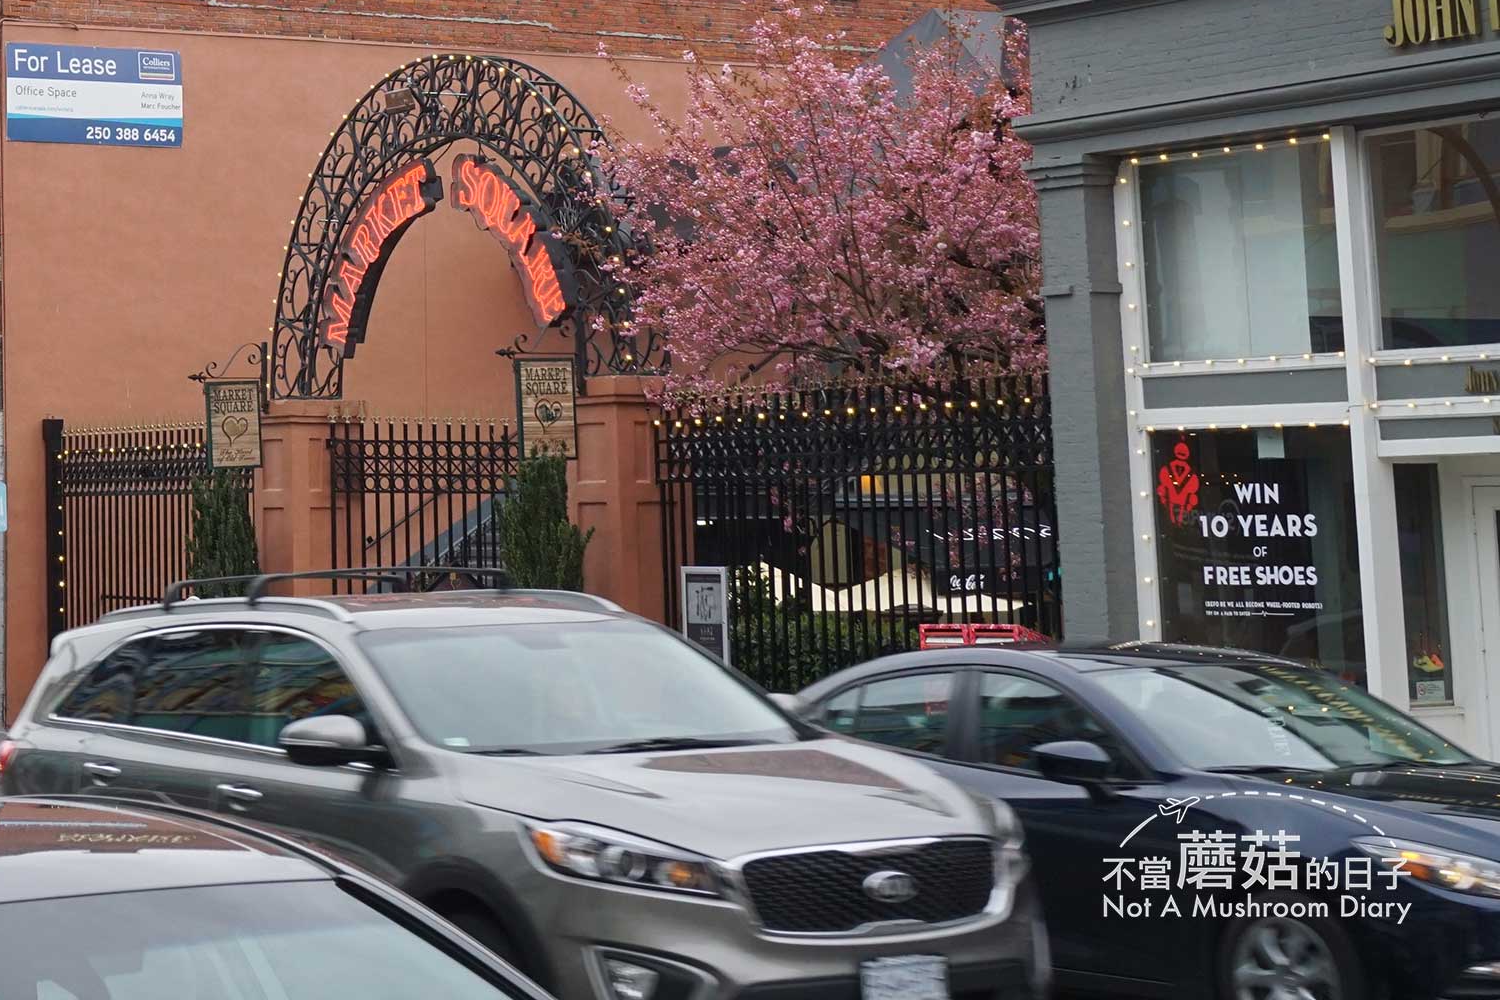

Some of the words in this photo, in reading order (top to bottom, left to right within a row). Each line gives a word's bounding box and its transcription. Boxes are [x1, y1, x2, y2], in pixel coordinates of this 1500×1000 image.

[14, 48, 49, 73] For
[56, 51, 117, 76] Lease
[142, 56, 171, 67] Colliers
[15, 85, 45, 97] Office
[47, 87, 77, 99] Space
[141, 91, 157, 99] Anna
[159, 92, 175, 101] Wray
[141, 102, 156, 110] Marc
[157, 103, 181, 111] Foucher
[86, 126, 111, 140] 250
[115, 127, 140, 141] 388
[143, 129, 176, 143] 6454
[459, 160, 566, 322] SQUARE
[327, 164, 427, 344] MARKET
[525, 367, 567, 381] MARKET
[213, 389, 253, 401] MARKET
[525, 381, 568, 398] SQUARE
[213, 401, 253, 416] SQUARE
[1233, 482, 1280, 504] WIN
[1199, 515, 1229, 538] 10
[1236, 513, 1318, 538] YEARS
[1252, 546, 1268, 558] OF
[1203, 566, 1252, 586] FREE
[1255, 565, 1318, 586] SHOES
